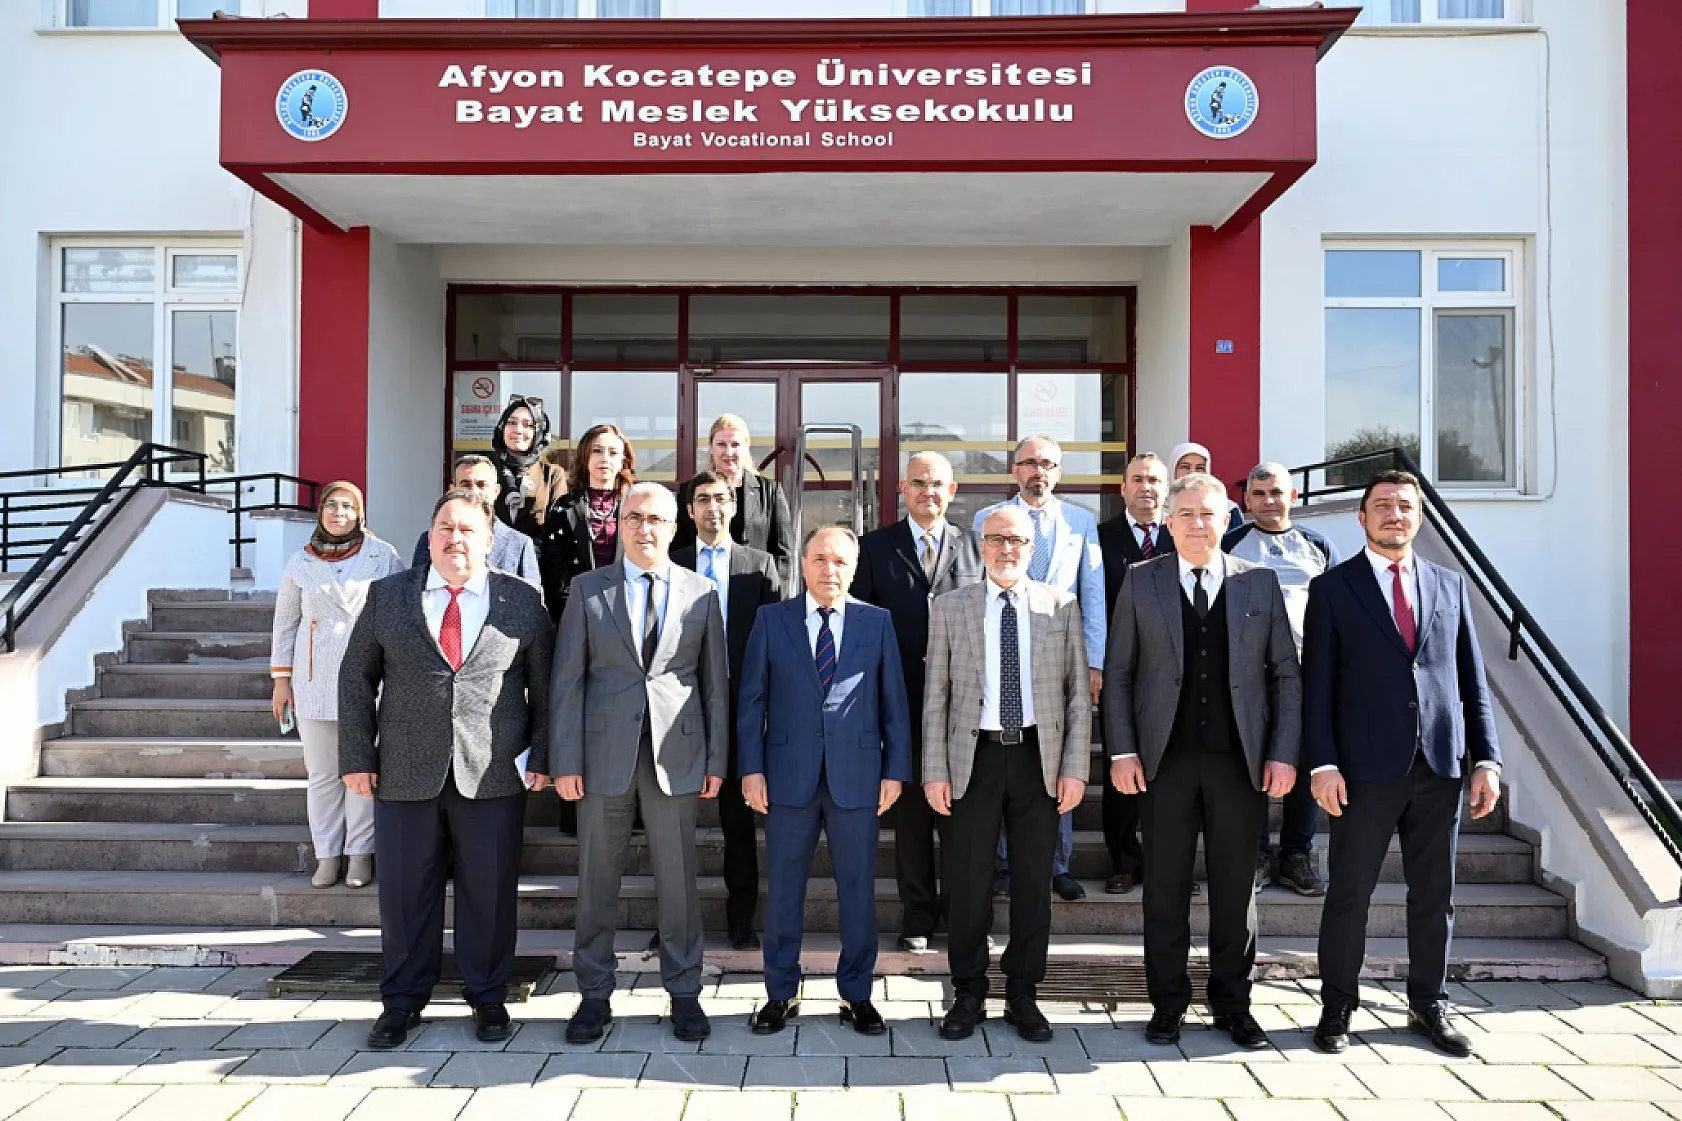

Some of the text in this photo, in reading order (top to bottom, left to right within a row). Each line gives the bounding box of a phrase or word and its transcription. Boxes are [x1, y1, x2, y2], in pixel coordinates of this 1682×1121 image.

[438, 58, 1092, 93] Afyon Kocatepe Üniversitesi
[455, 98, 1074, 128] Bayat Meslek Yüksekokulu
[632, 131, 894, 150] Bayat Vocational School
